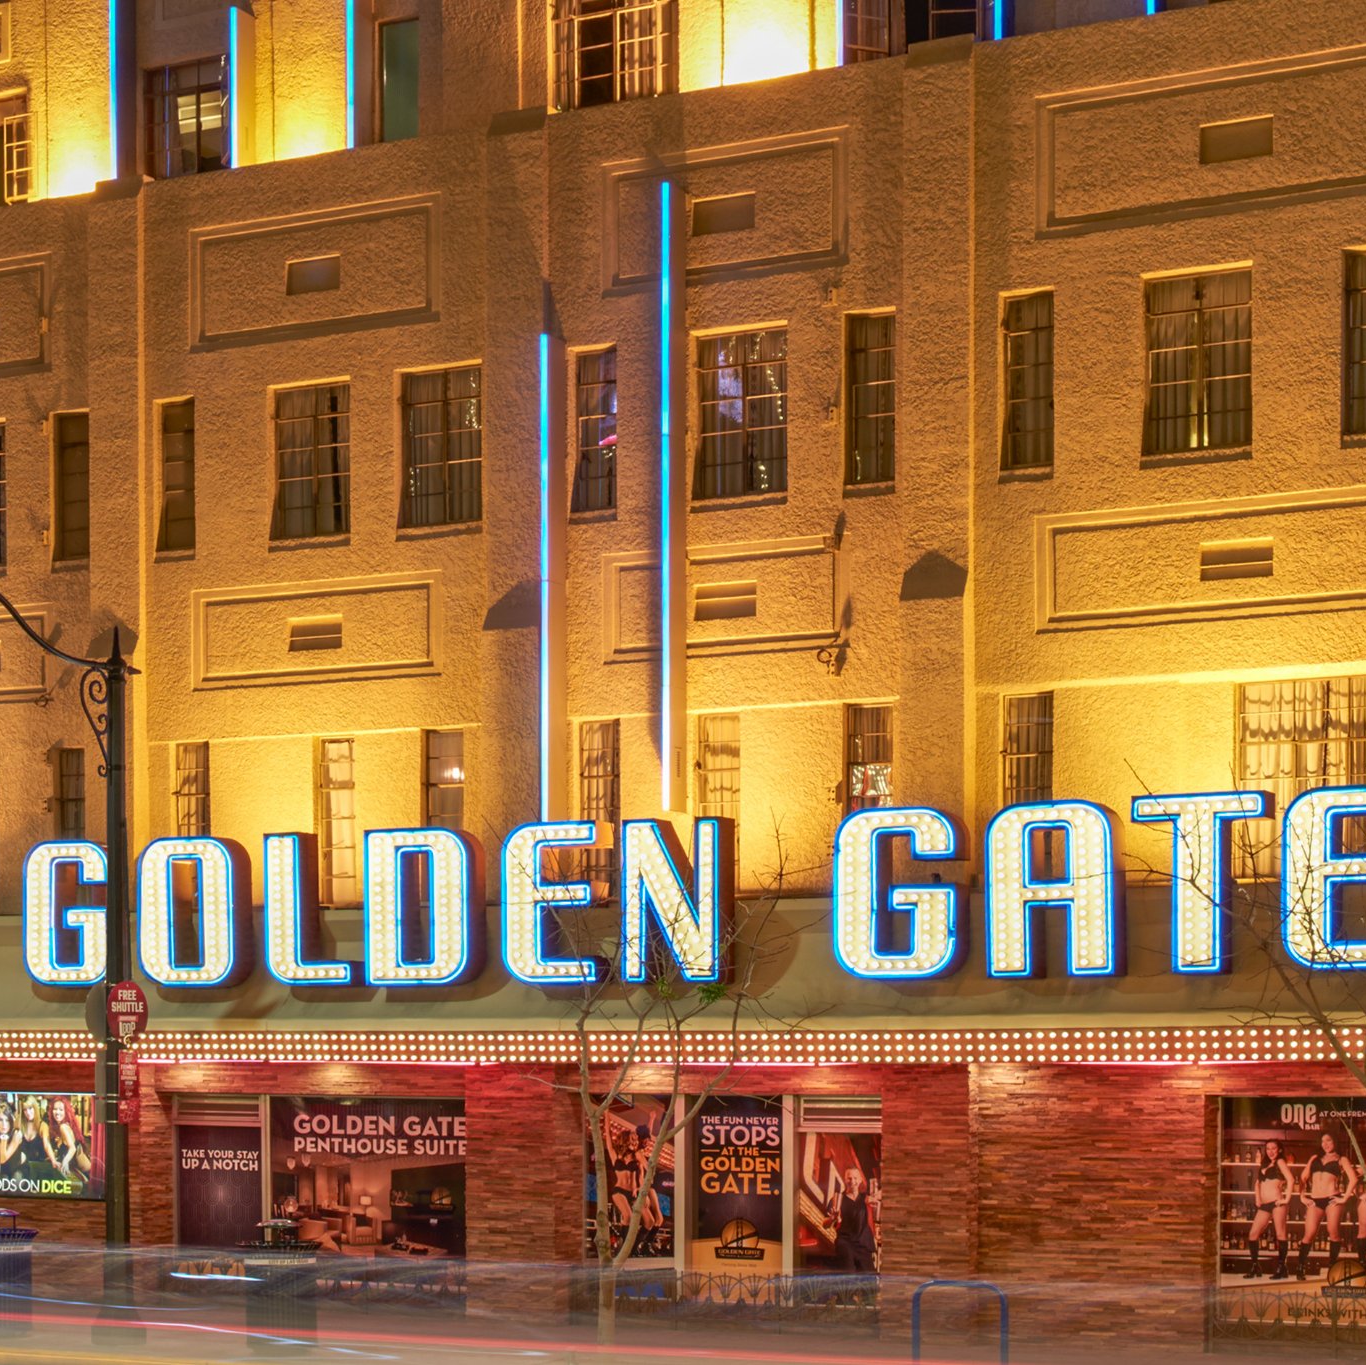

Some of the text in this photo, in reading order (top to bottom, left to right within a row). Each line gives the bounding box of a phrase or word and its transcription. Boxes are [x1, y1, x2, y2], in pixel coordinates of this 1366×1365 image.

[23, 817, 721, 986] GOLDEN
[118, 990, 137, 1001] FREE
[111, 1002, 144, 1013] SHUTTLE
[293, 1113, 466, 1137] GOLDEN GATE
[701, 1115, 779, 1125] THE FUN NEVER
[701, 1125, 780, 1146] STOPS
[294, 1136, 466, 1156] PENTHOUSE SUITE
[721, 1147, 759, 1156] AT THE
[182, 1149, 259, 1160] TAKE YOUR STAY
[182, 1159, 259, 1171] UP A NOTCH
[700, 1156, 780, 1172] GOLDEN
[19, 1178, 40, 1193] ON
[41, 1180, 72, 1194] DICE
[700, 1172, 780, 1195] GATE.
